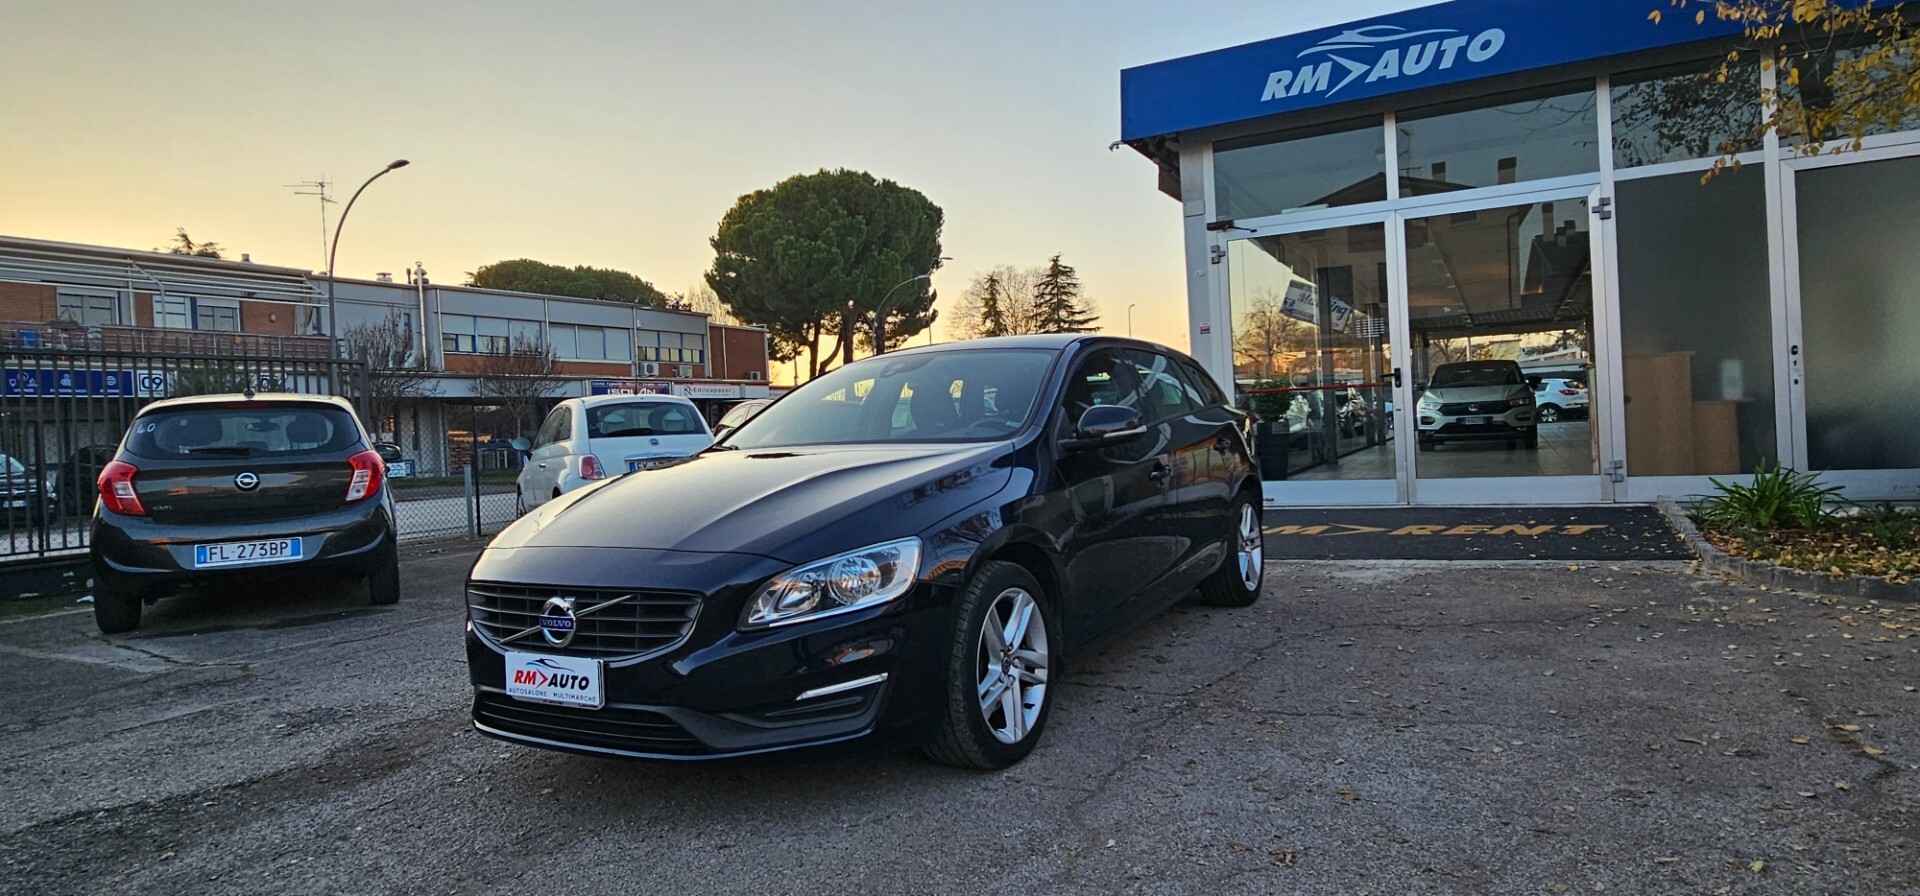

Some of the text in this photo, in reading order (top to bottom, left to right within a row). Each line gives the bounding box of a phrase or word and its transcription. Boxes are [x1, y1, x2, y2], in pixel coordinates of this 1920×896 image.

[1260, 28, 1506, 102] RM AUTO
[1387, 524, 1609, 535] RENT
[209, 541, 289, 561] FL 273BP
[541, 618, 572, 627] VOLVO
[514, 669, 589, 690] RM AUTO
[509, 687, 547, 697] AUTOSALONE
[553, 691, 596, 702] MULTIMARCHE
